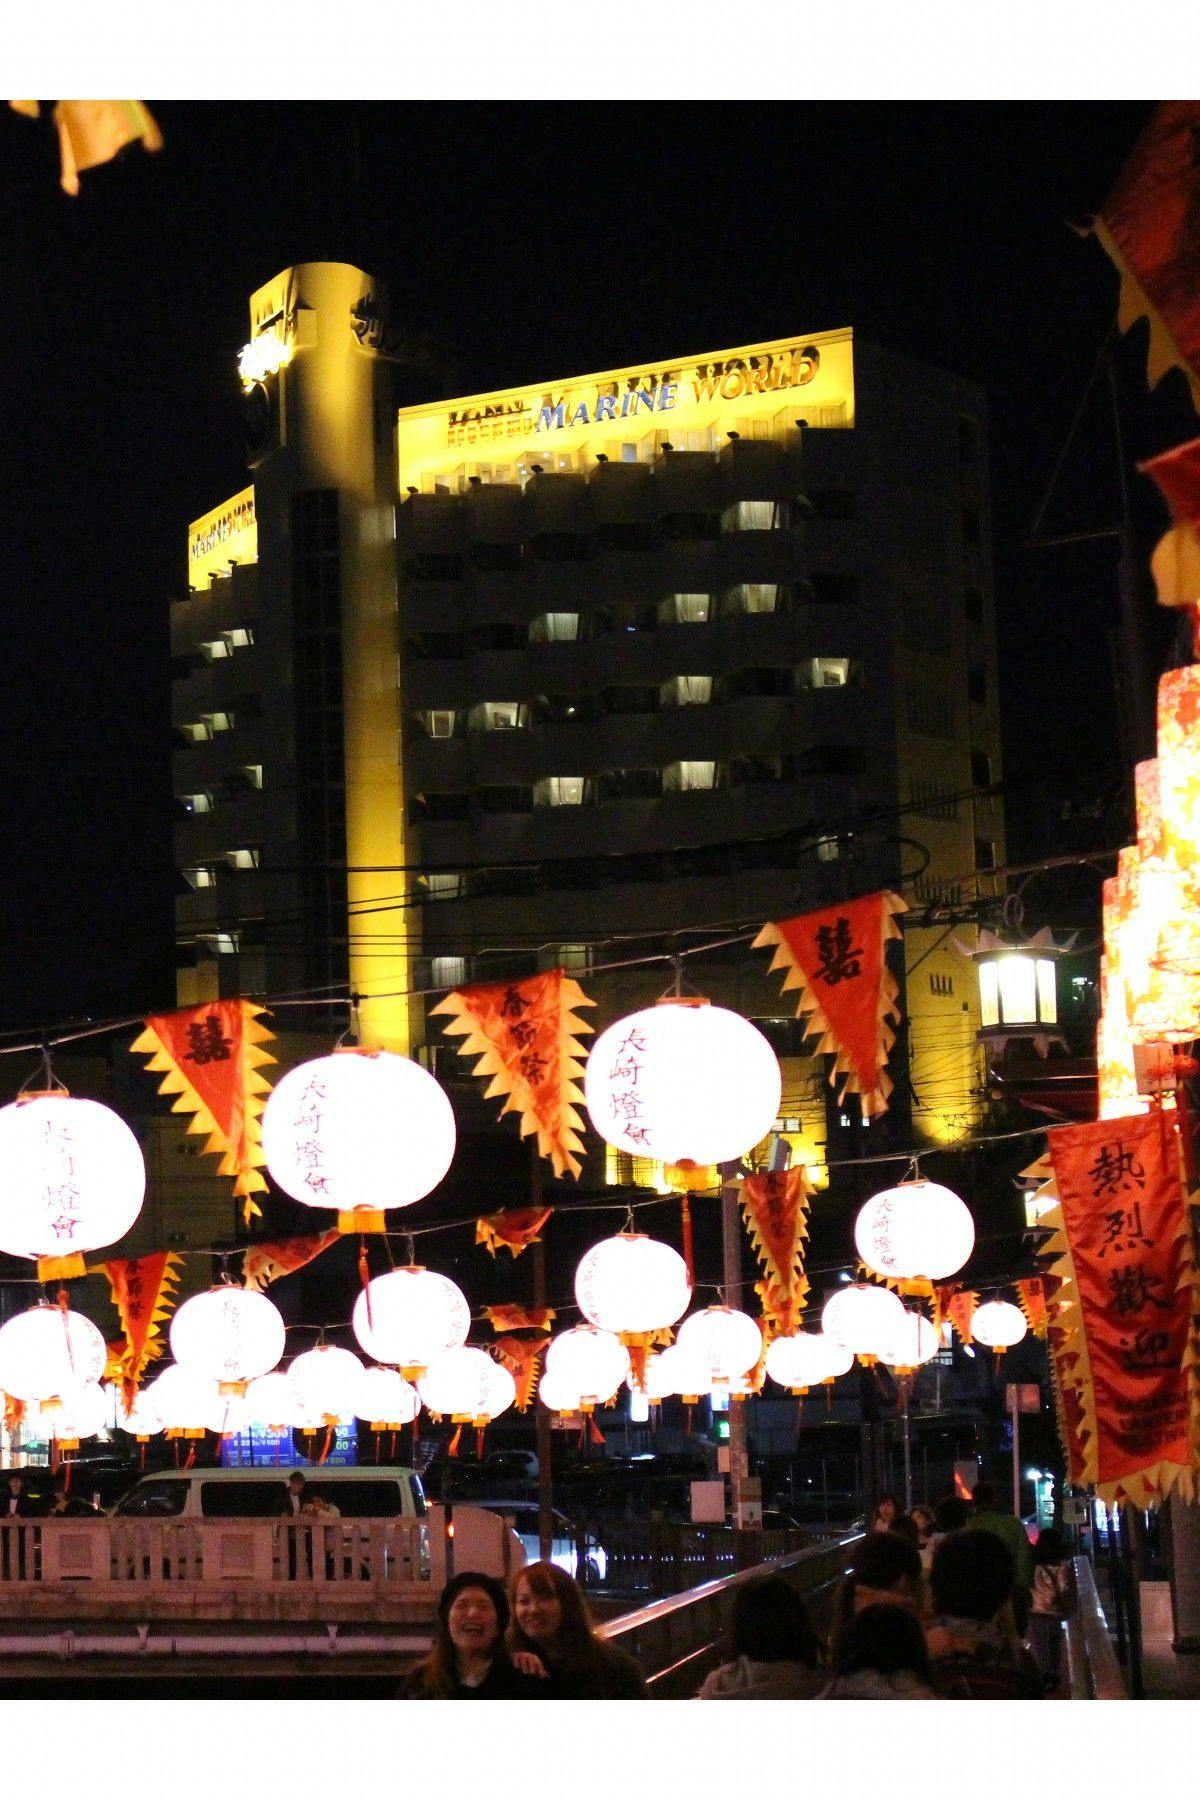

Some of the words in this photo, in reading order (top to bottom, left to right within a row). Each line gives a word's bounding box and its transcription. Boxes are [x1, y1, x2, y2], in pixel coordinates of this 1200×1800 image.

[534, 384, 678, 433] MARINE
[692, 350, 818, 404] WORLD
[608, 1027, 652, 1147] 長崎燈會
